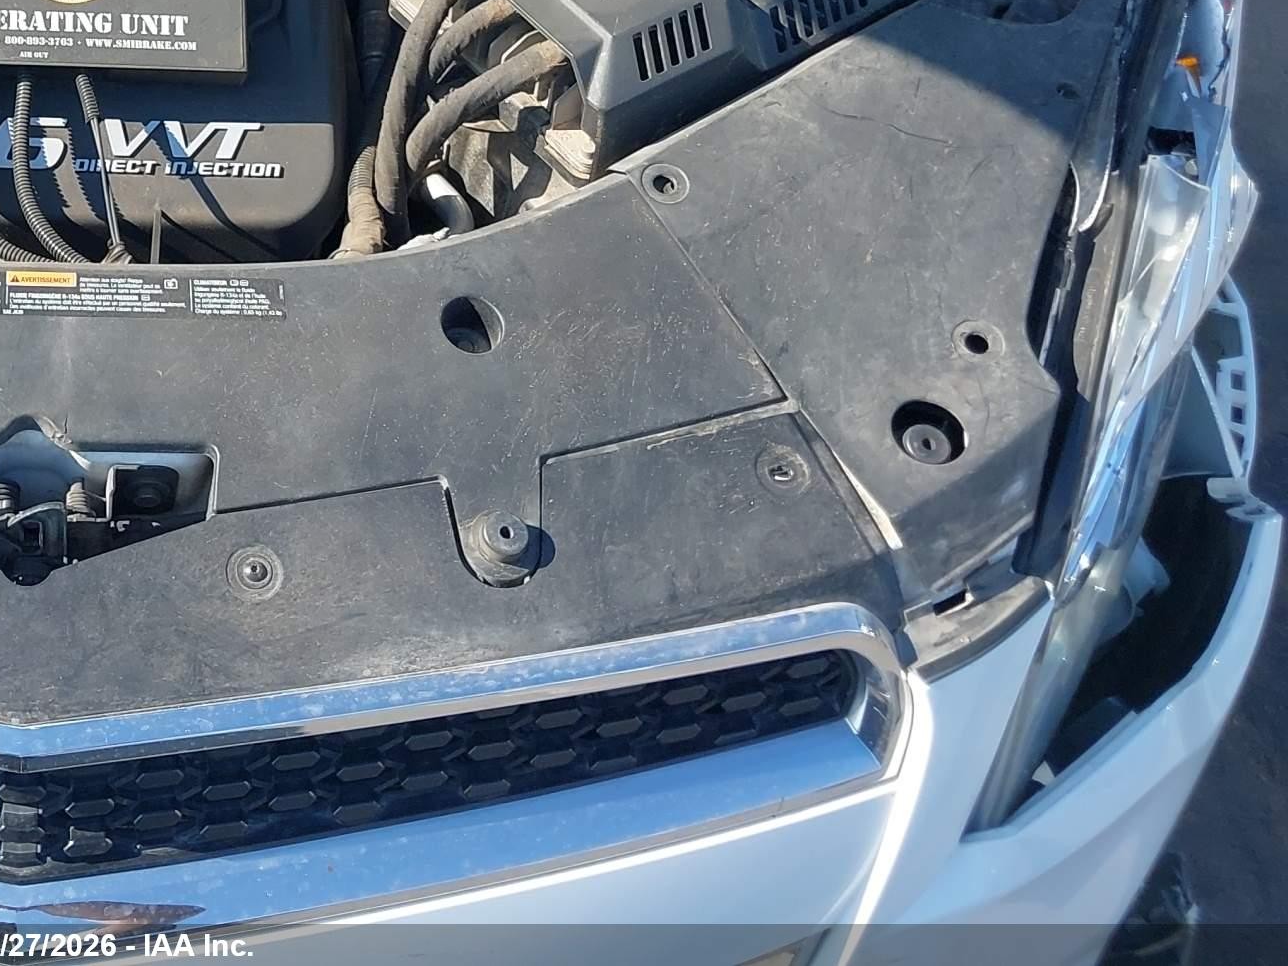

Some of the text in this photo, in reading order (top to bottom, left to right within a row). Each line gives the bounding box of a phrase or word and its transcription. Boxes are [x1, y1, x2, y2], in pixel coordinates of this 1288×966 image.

[119, 13, 190, 37] UNIT
[85, 38, 197, 51] WWW.SMIBRAKE.COM
[18, 50, 33, 58] AIR
[103, 118, 263, 161] VVT
[76, 158, 284, 177] DIRECT INJECTION
[20, 276, 71, 284] AVERTISSEMENT
